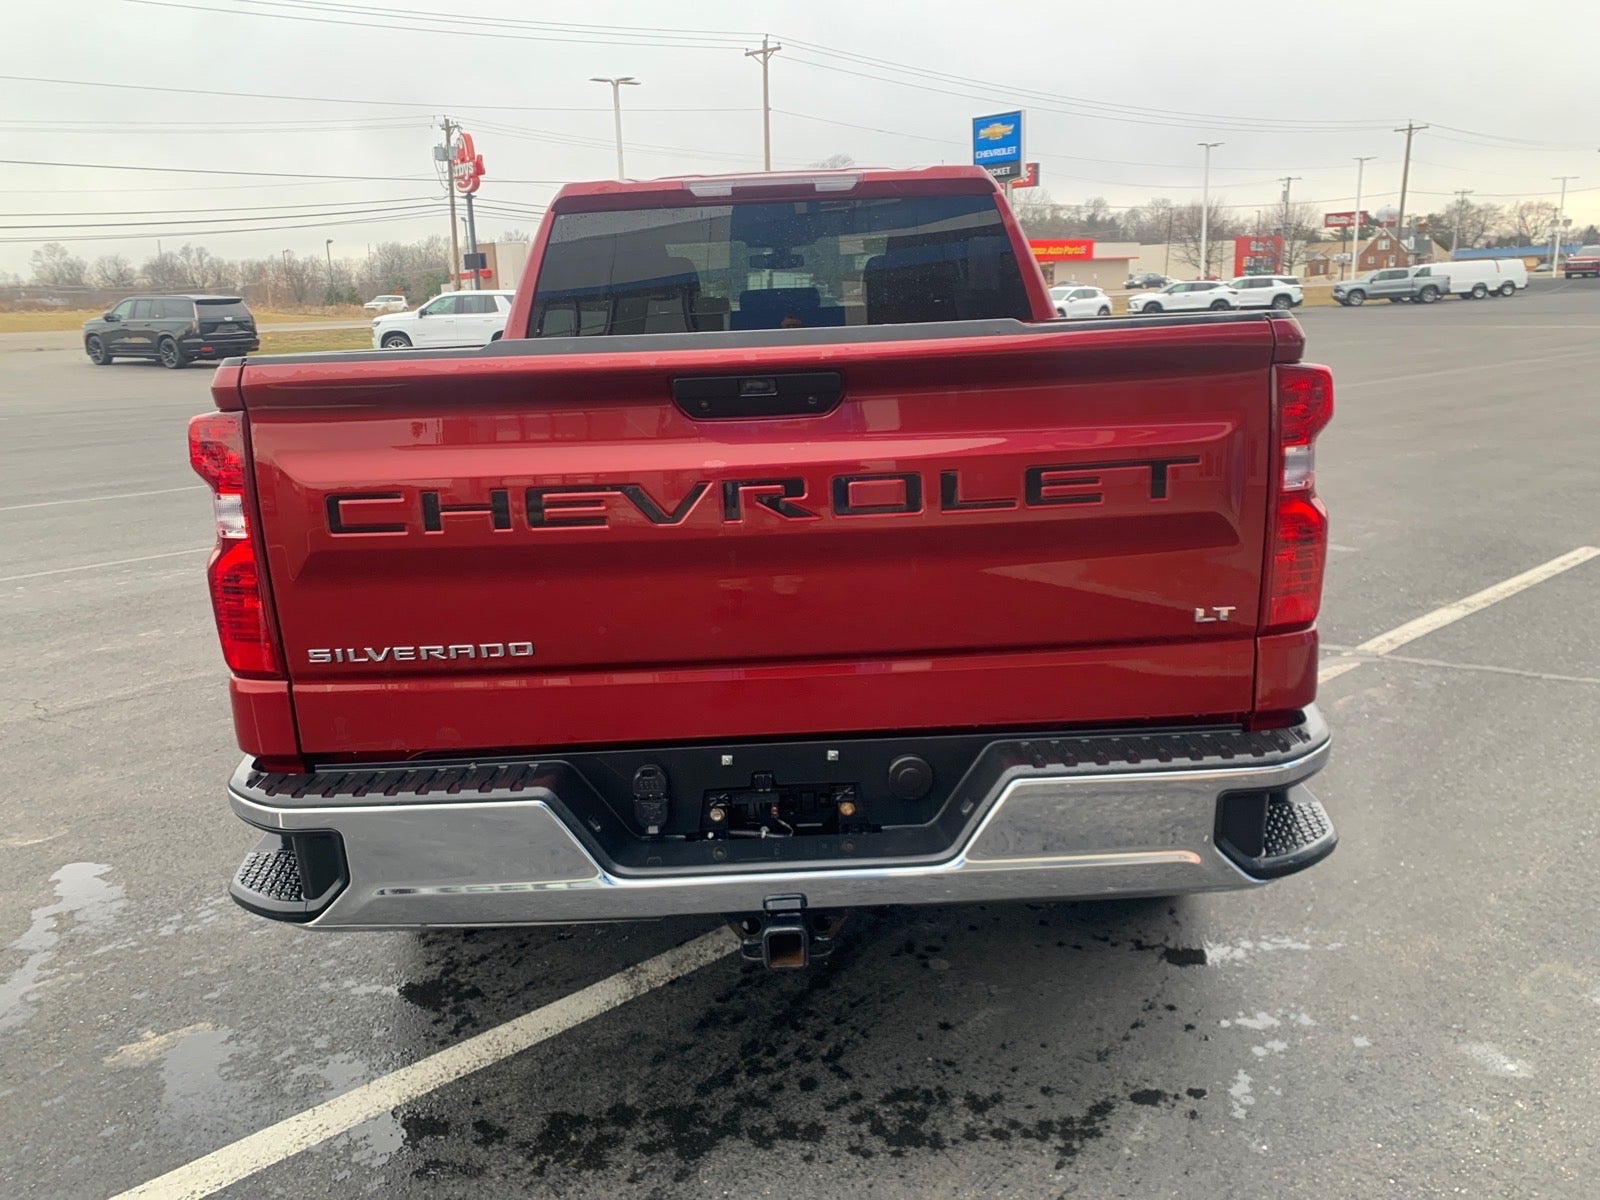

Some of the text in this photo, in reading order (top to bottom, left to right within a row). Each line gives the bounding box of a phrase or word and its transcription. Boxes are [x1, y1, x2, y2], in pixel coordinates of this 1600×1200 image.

[976, 146, 1016, 158] CHEVROLET
[988, 166, 1011, 176] OCKET
[325, 459, 1199, 536] CHEVROLET
[1195, 606, 1236, 622] LT
[307, 641, 534, 664] SILVERADO
